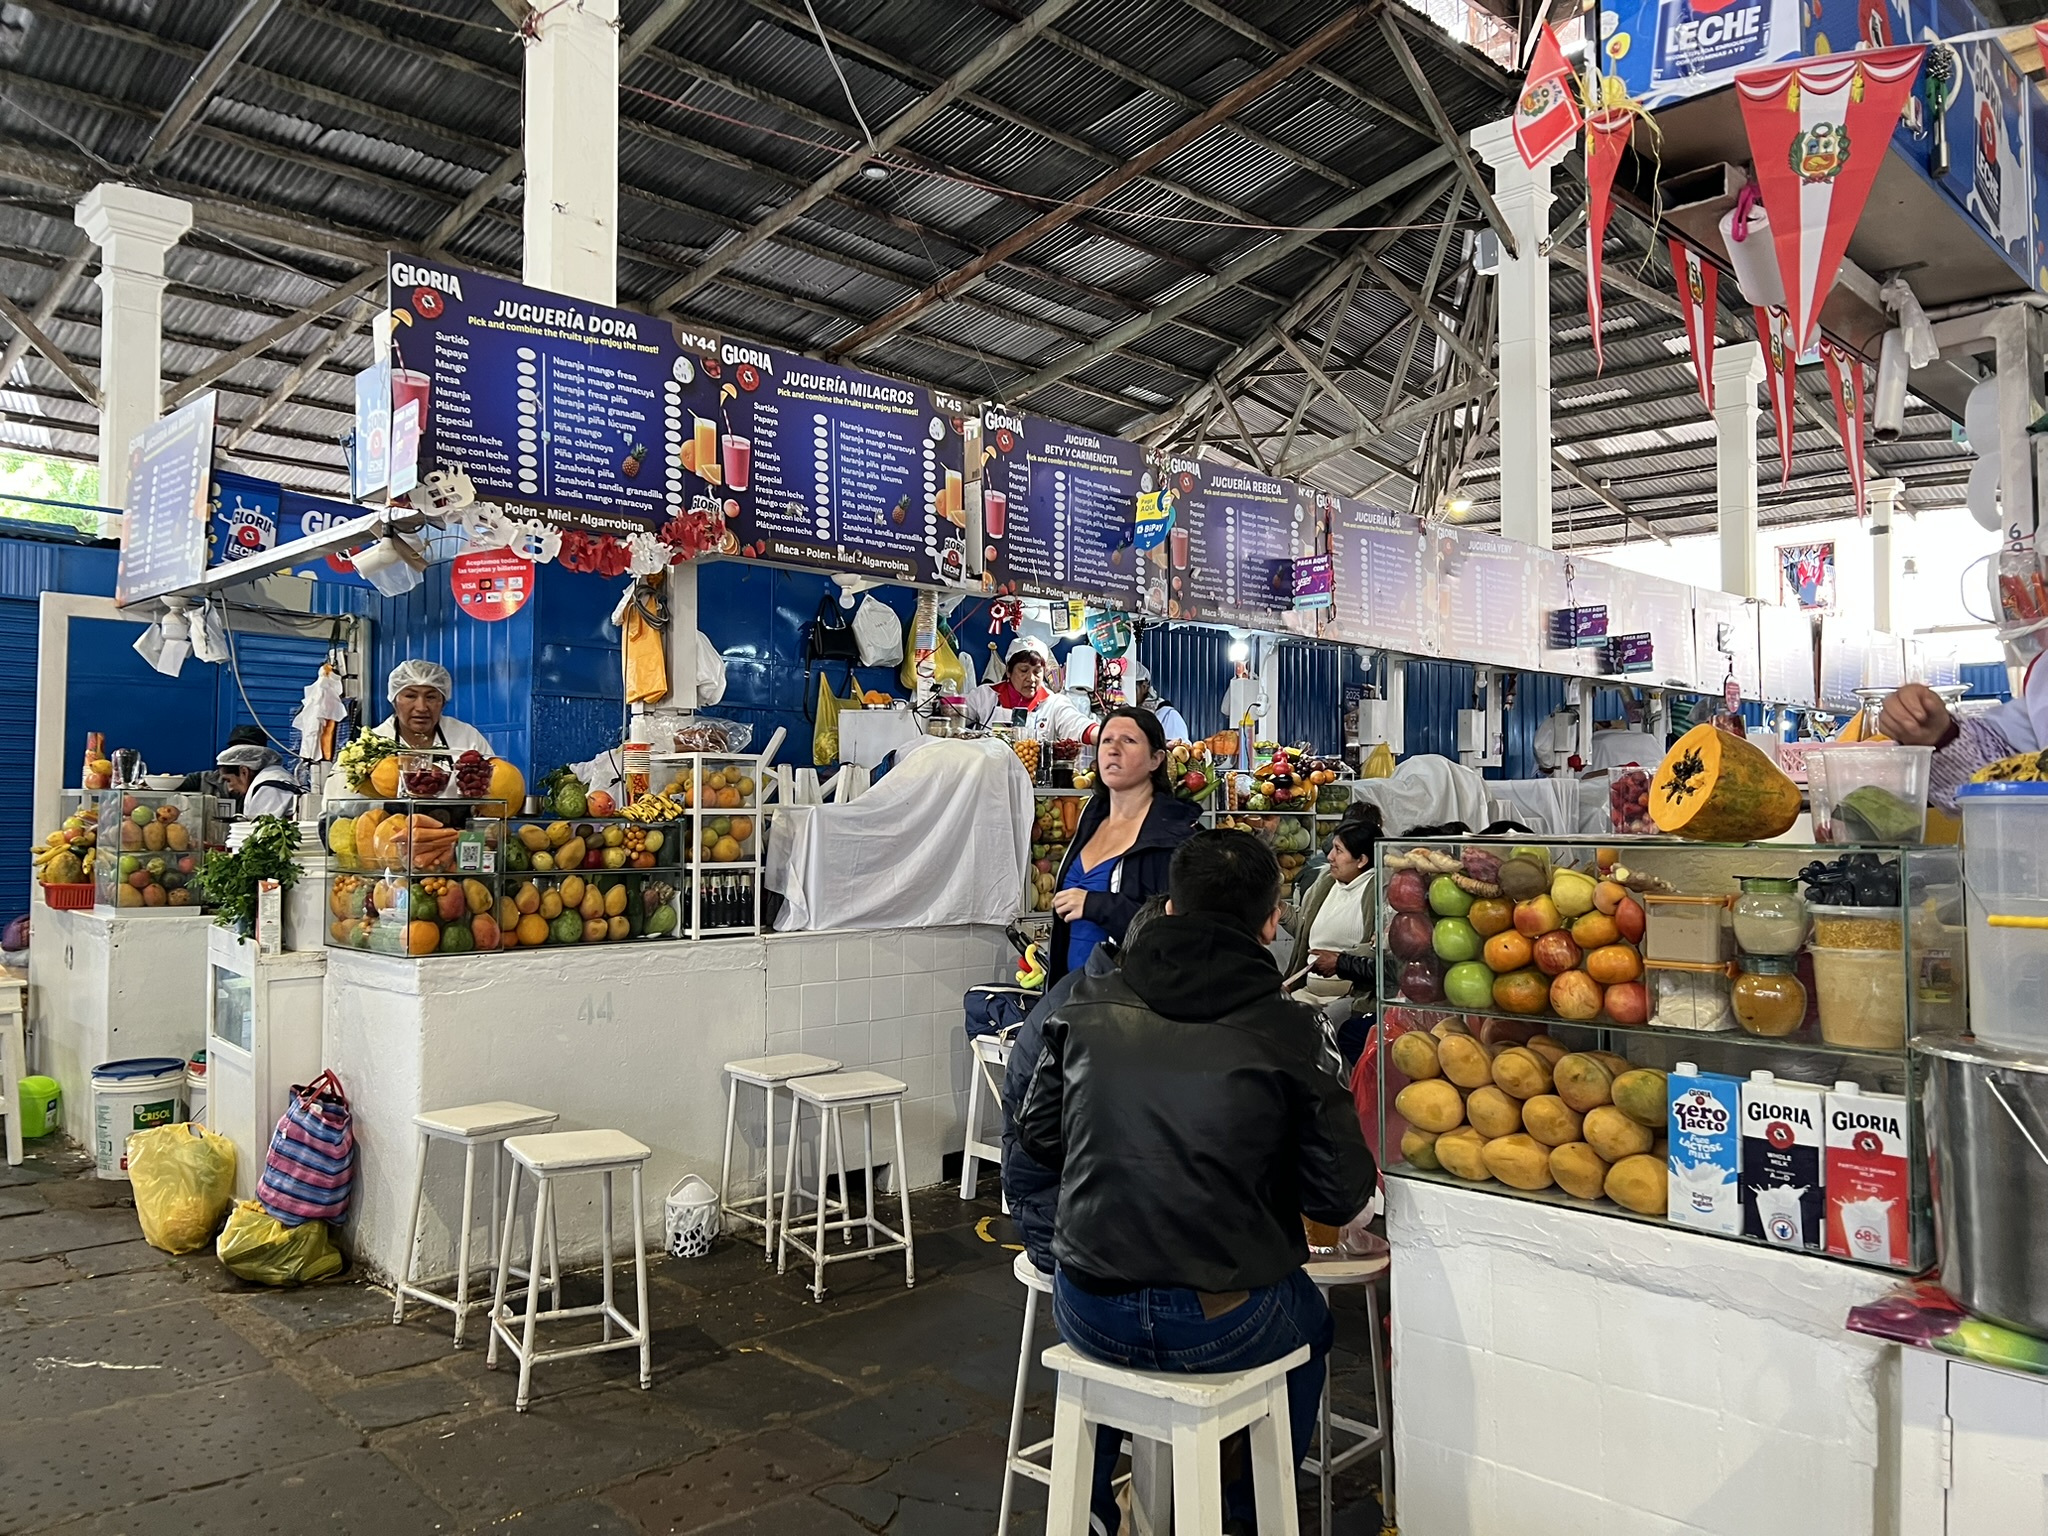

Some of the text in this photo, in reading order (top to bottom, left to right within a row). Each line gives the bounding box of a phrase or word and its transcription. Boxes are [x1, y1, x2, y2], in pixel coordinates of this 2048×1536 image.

[1666, 6, 1761, 54] LECHE
[392, 262, 463, 302] GLORIA
[494, 300, 638, 340] JUGUERÍA DORA
[435, 331, 469, 346] Surtido
[468, 316, 659, 354] Pick and combine the fruits you enjoy the most!
[435, 345, 469, 360] Papaya
[721, 344, 774, 376] GLORIA
[435, 359, 467, 374] Mango
[553, 356, 637, 382] Naranja mango fresa
[435, 372, 460, 385] Fresa
[553, 369, 655, 399] Naranja mango maracuyá
[435, 386, 471, 401] Naranja
[553, 383, 628, 406] Naranja fresa piña
[782, 370, 914, 405] JUGUERÍA MILAGROS
[436, 400, 471, 414] Plátano
[553, 395, 646, 421] Naranja piña granadilla
[754, 402, 778, 414] Surtido
[777, 388, 791, 398] Pick
[792, 390, 804, 399] and
[805, 392, 832, 403] combine
[833, 397, 843, 405] the
[844, 397, 861, 408] fruits
[862, 402, 874, 410] you
[875, 403, 891, 413] enjoy
[902, 408, 918, 416] most!
[436, 414, 473, 428] Especial
[754, 414, 778, 426] Papaya
[985, 412, 1024, 439] GLORIA
[436, 428, 503, 447] Fresa con leche
[554, 422, 602, 439] Piña mango
[754, 426, 777, 438] Mango
[840, 421, 902, 441] Naranja mango fresa
[554, 434, 614, 454] Piña chirimoya
[754, 437, 772, 448] Fresa
[1064, 434, 1100, 449] JUGUERÍA
[436, 442, 509, 461] Mango con leche
[754, 450, 781, 462] Naranja
[1045, 444, 1118, 466] BETY Y CARMENCITA
[470, 462, 487, 471] con
[488, 463, 511, 475] leche
[554, 460, 615, 479] Zanahoria piña
[755, 461, 781, 472] Plátano
[1009, 461, 1028, 472] Surtido
[1170, 458, 1201, 479] GLORIA
[472, 477, 513, 489] con leche
[755, 473, 782, 484] Especial
[1009, 472, 1028, 482] Papaya
[755, 485, 804, 500] Fresa con leche
[1211, 476, 1282, 495] JUGUERÍA REBECA
[585, 492, 613, 505] mango
[842, 489, 886, 504] Piña chirimoya
[232, 511, 272, 537] GLORIA
[504, 502, 644, 533] Polen Miel Algarrobina
[1355, 511, 1388, 526] JUGUERÍA
[756, 520, 812, 536] Plátano con leche
[1437, 527, 1459, 544] GLORIA
[775, 543, 909, 572] Maca Polen Miel Algarrobina
[943, 563, 960, 576] LECHE
[461, 582, 476, 590] VISA
[1022, 583, 1040, 594] Maca
[1689, 1089, 1712, 1100] GLORIA
[139, 1109, 170, 1122] CRISOL
[1674, 1102, 1727, 1122] zero
[1748, 1102, 1813, 1130] GLORIA
[1680, 1112, 1725, 1132] lacto
[1832, 1110, 1901, 1140] GLORIA
[1767, 1152, 1792, 1161] WHOLE
[1771, 1159, 1788, 1167] MILK
[1855, 1228, 1882, 1244] 68%
